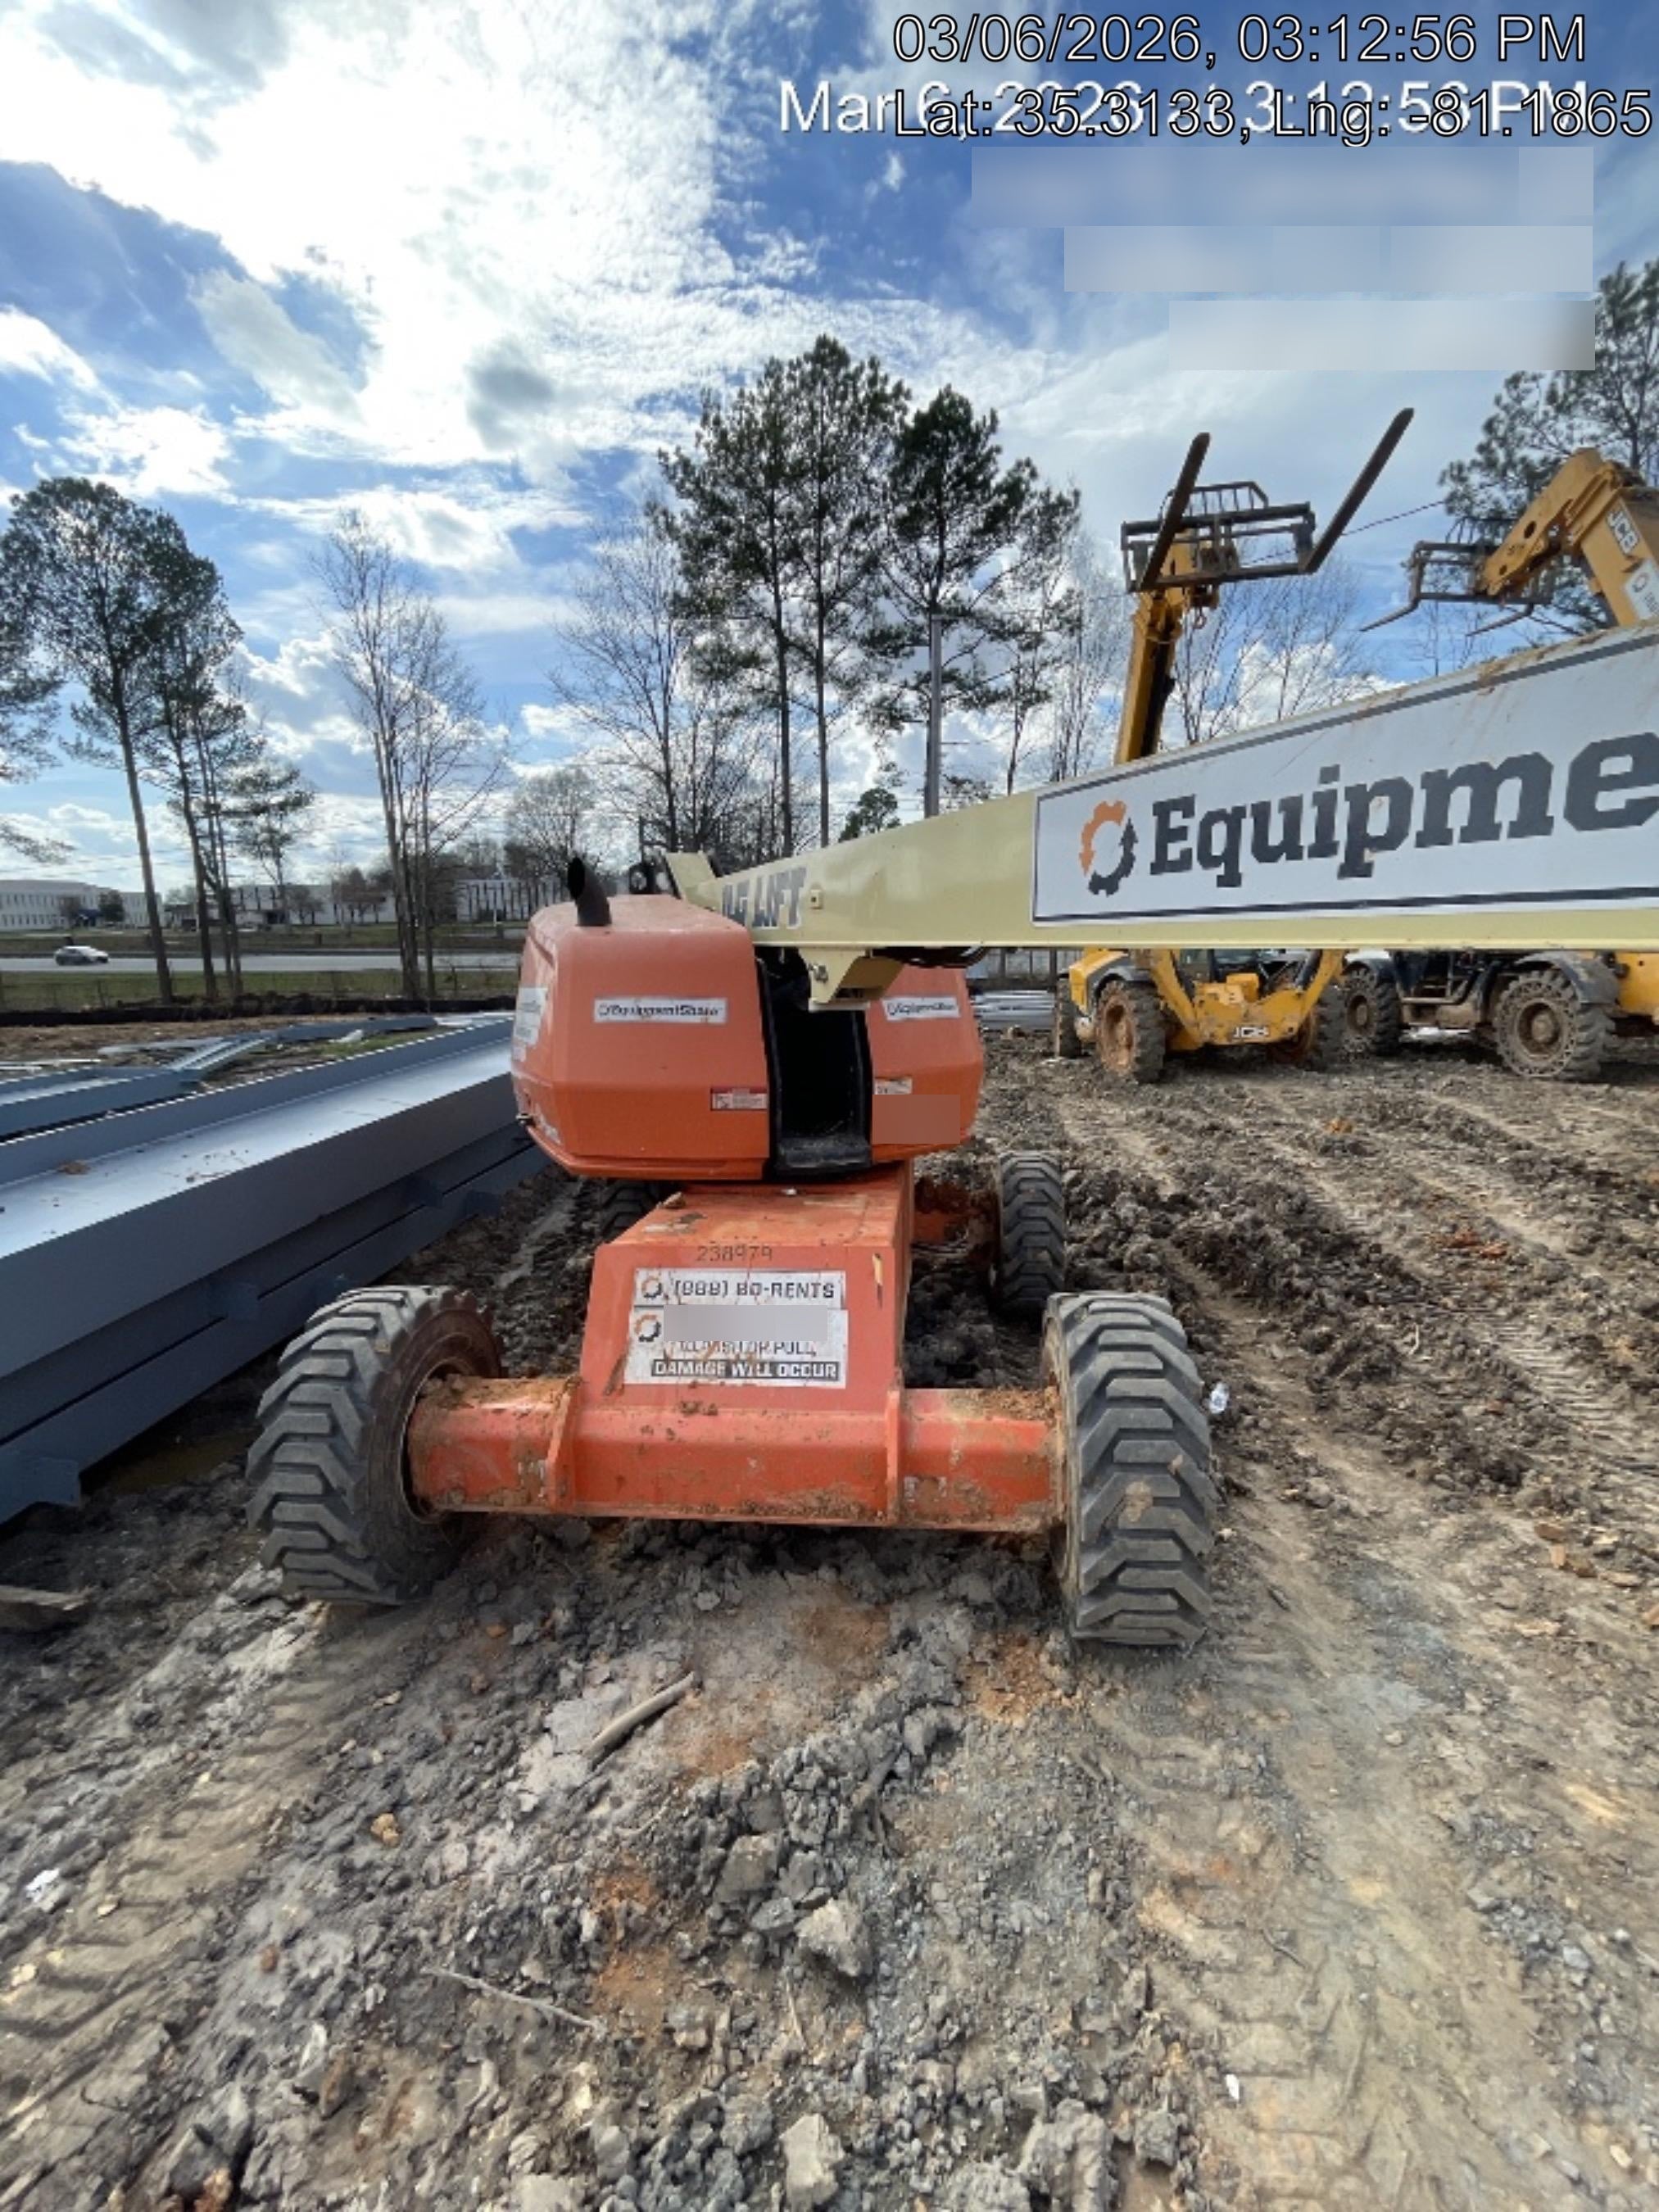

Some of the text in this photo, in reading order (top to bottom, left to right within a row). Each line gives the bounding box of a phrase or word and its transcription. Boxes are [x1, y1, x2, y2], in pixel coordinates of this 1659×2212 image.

[1606, 510, 1639, 555] JCB
[1149, 732, 1659, 889] Equipme
[777, 1362, 837, 1379] OCCUR
